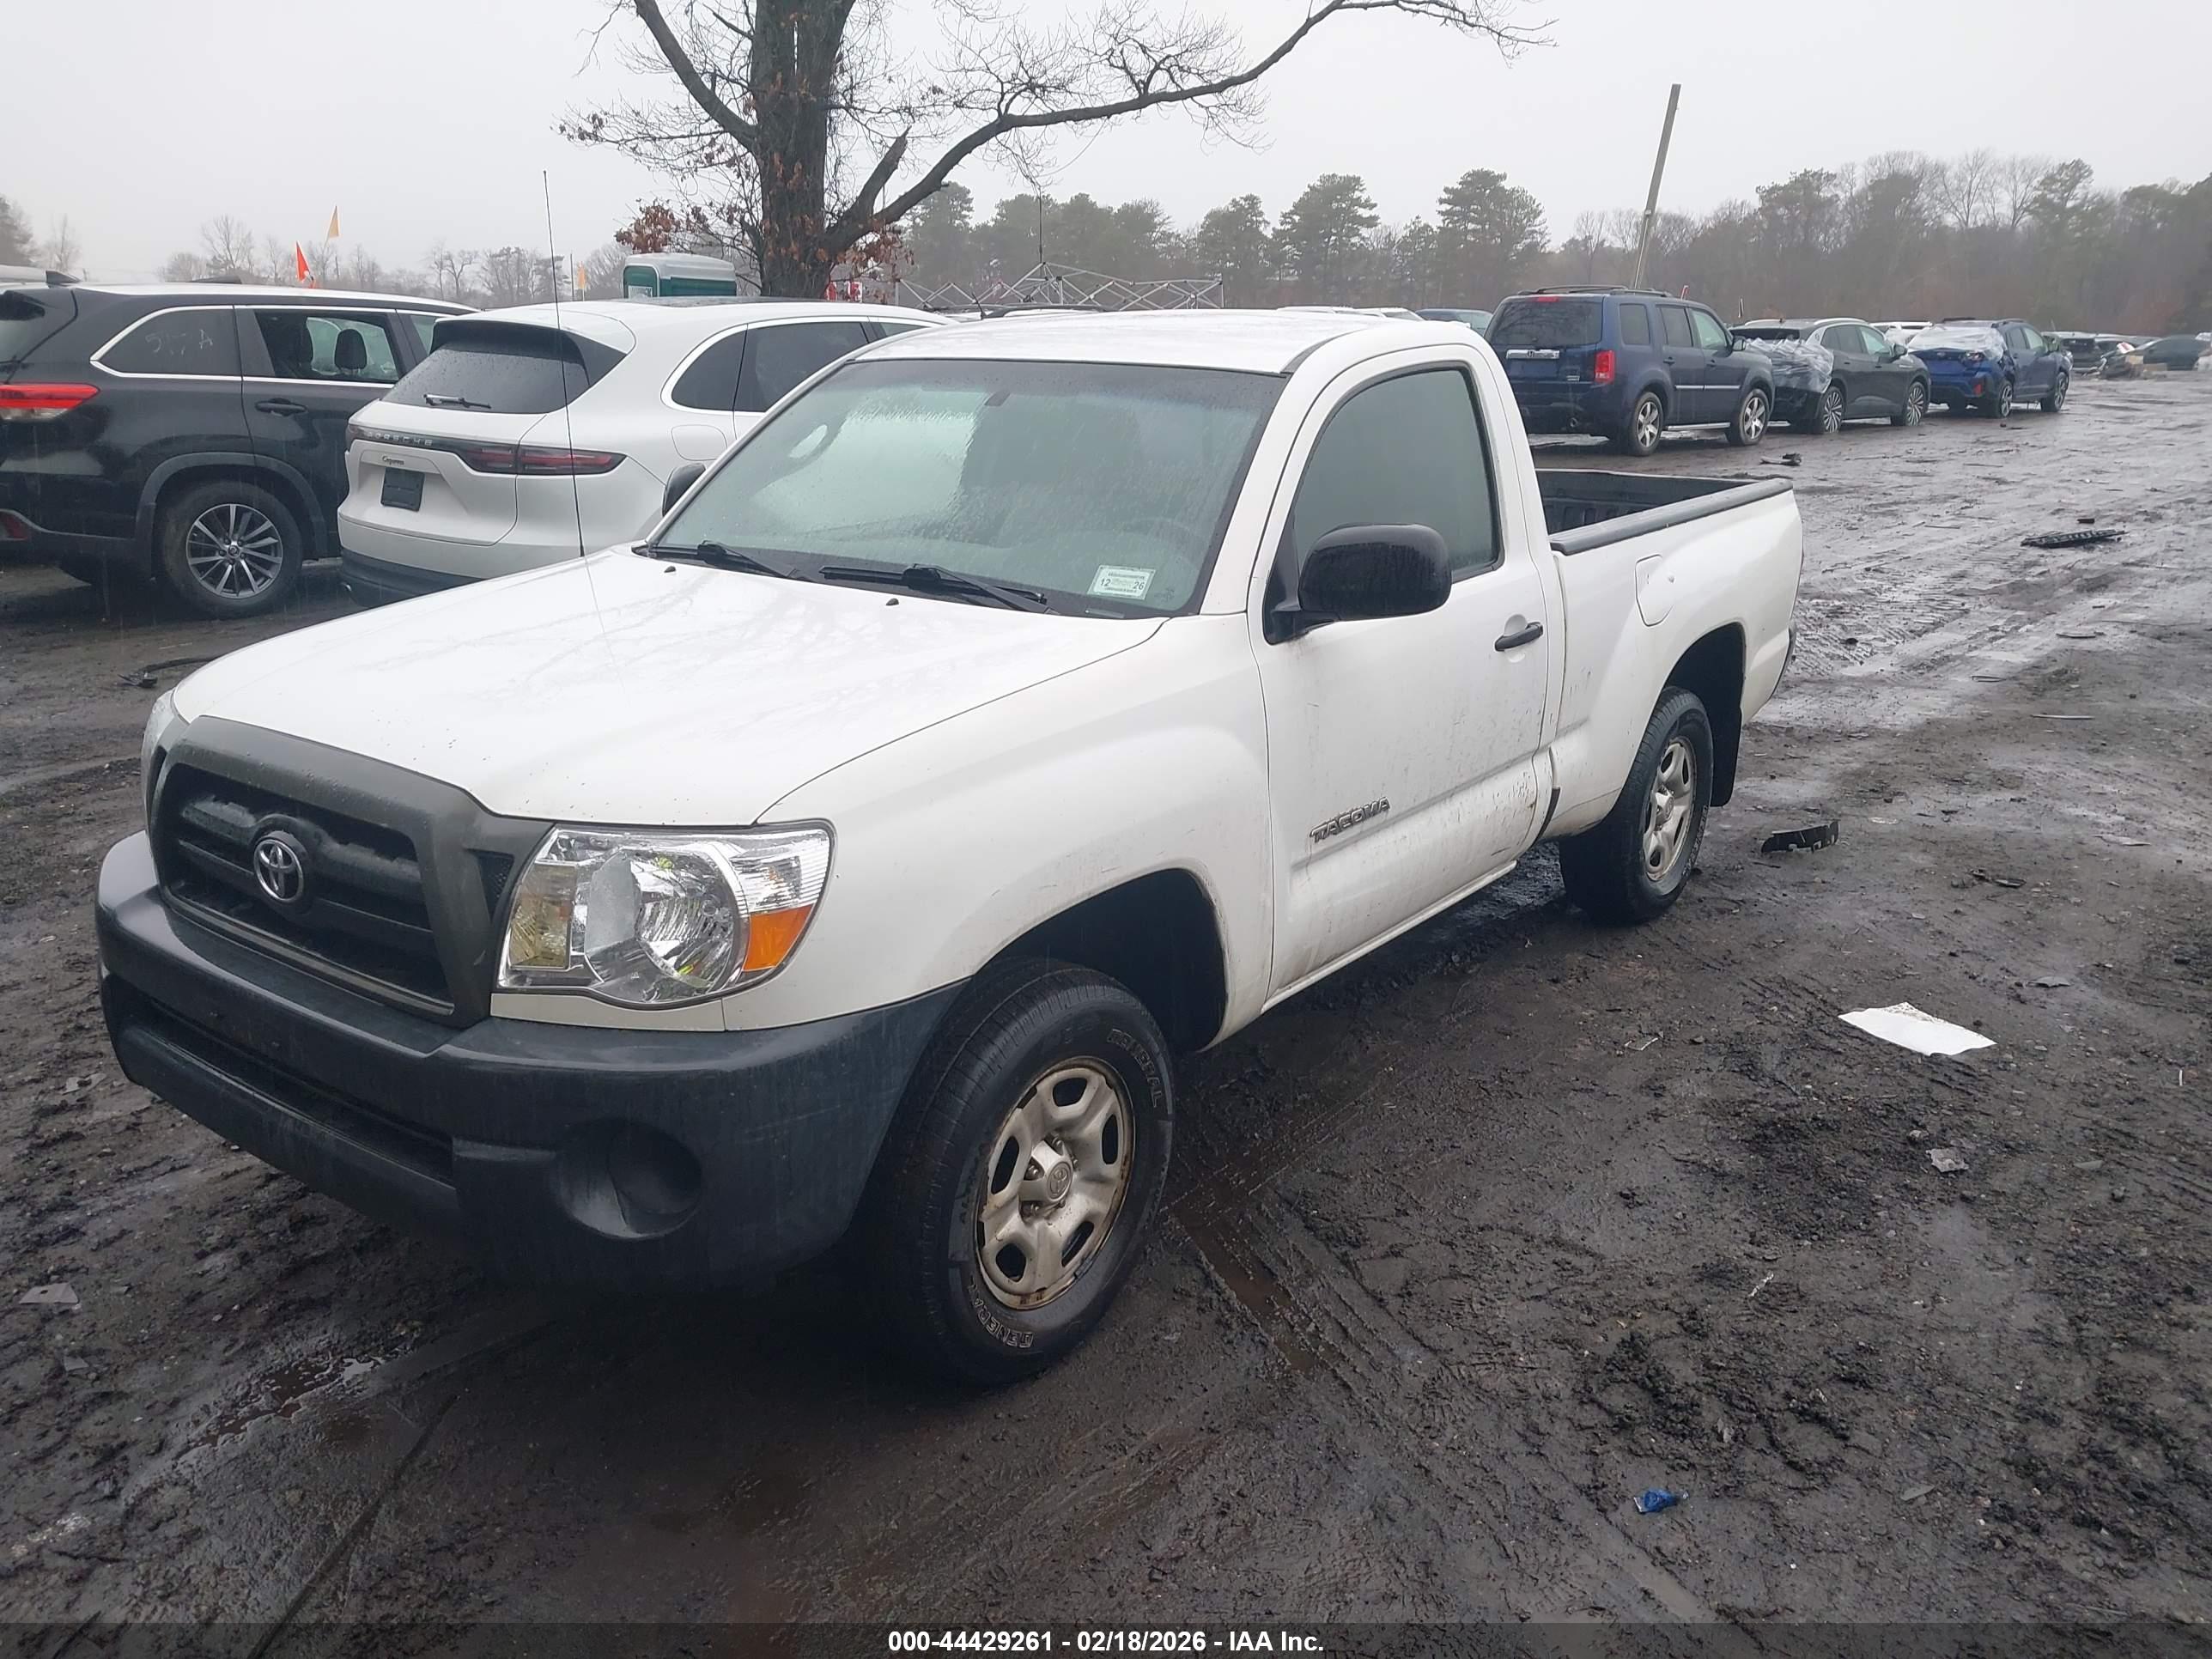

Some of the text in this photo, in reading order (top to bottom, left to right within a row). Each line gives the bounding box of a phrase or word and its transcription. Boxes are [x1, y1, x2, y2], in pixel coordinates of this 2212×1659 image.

[1100, 578, 1111, 587] 12
[1133, 580, 1146, 591] 26
[1309, 796, 1391, 843] TACOMA
